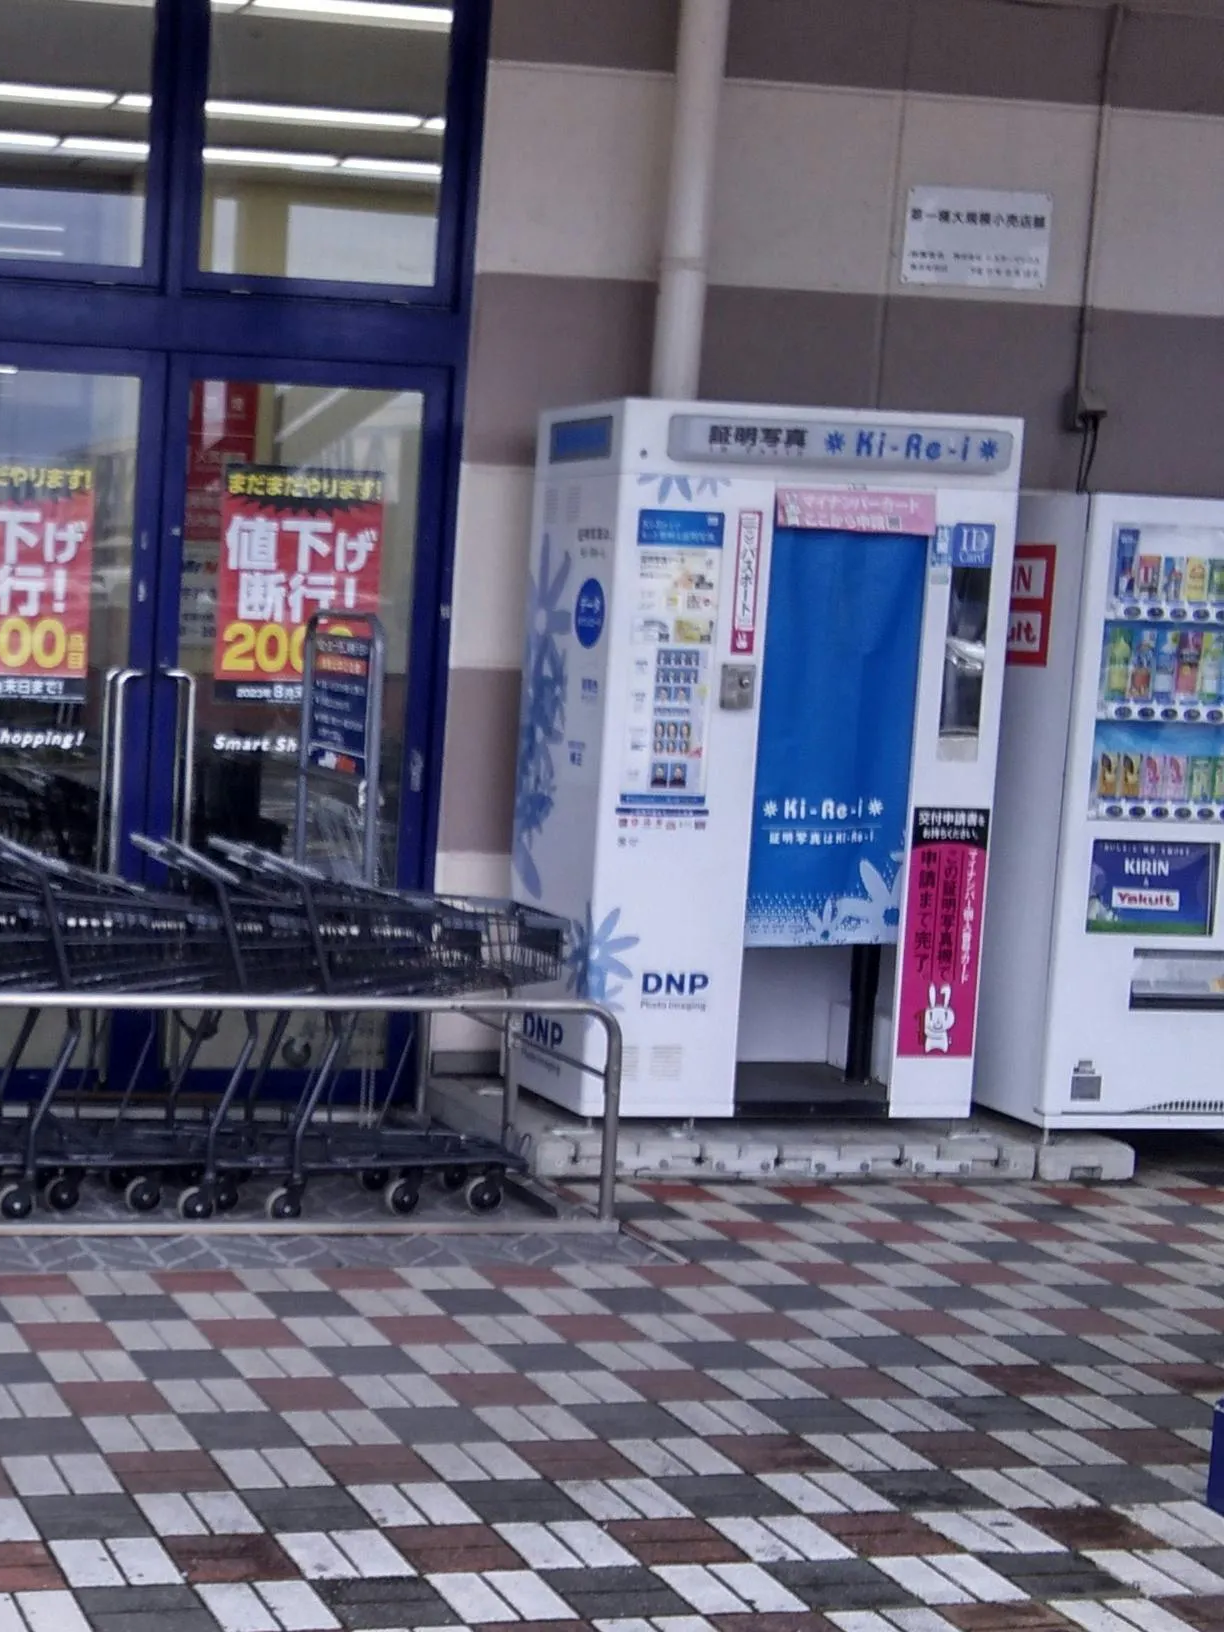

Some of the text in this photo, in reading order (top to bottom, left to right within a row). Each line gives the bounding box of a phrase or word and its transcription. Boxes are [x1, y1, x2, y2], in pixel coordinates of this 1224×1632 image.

[709, 425, 809, 448] 証明写真
[226, 514, 378, 573] 値下げ
[213, 733, 271, 752] Smart
[784, 797, 864, 820] Ki-Re-i
[1124, 857, 1170, 877] KIRIN
[1117, 891, 1176, 908] Yakult
[641, 972, 710, 996] DNP
[522, 1010, 564, 1050] DNP
